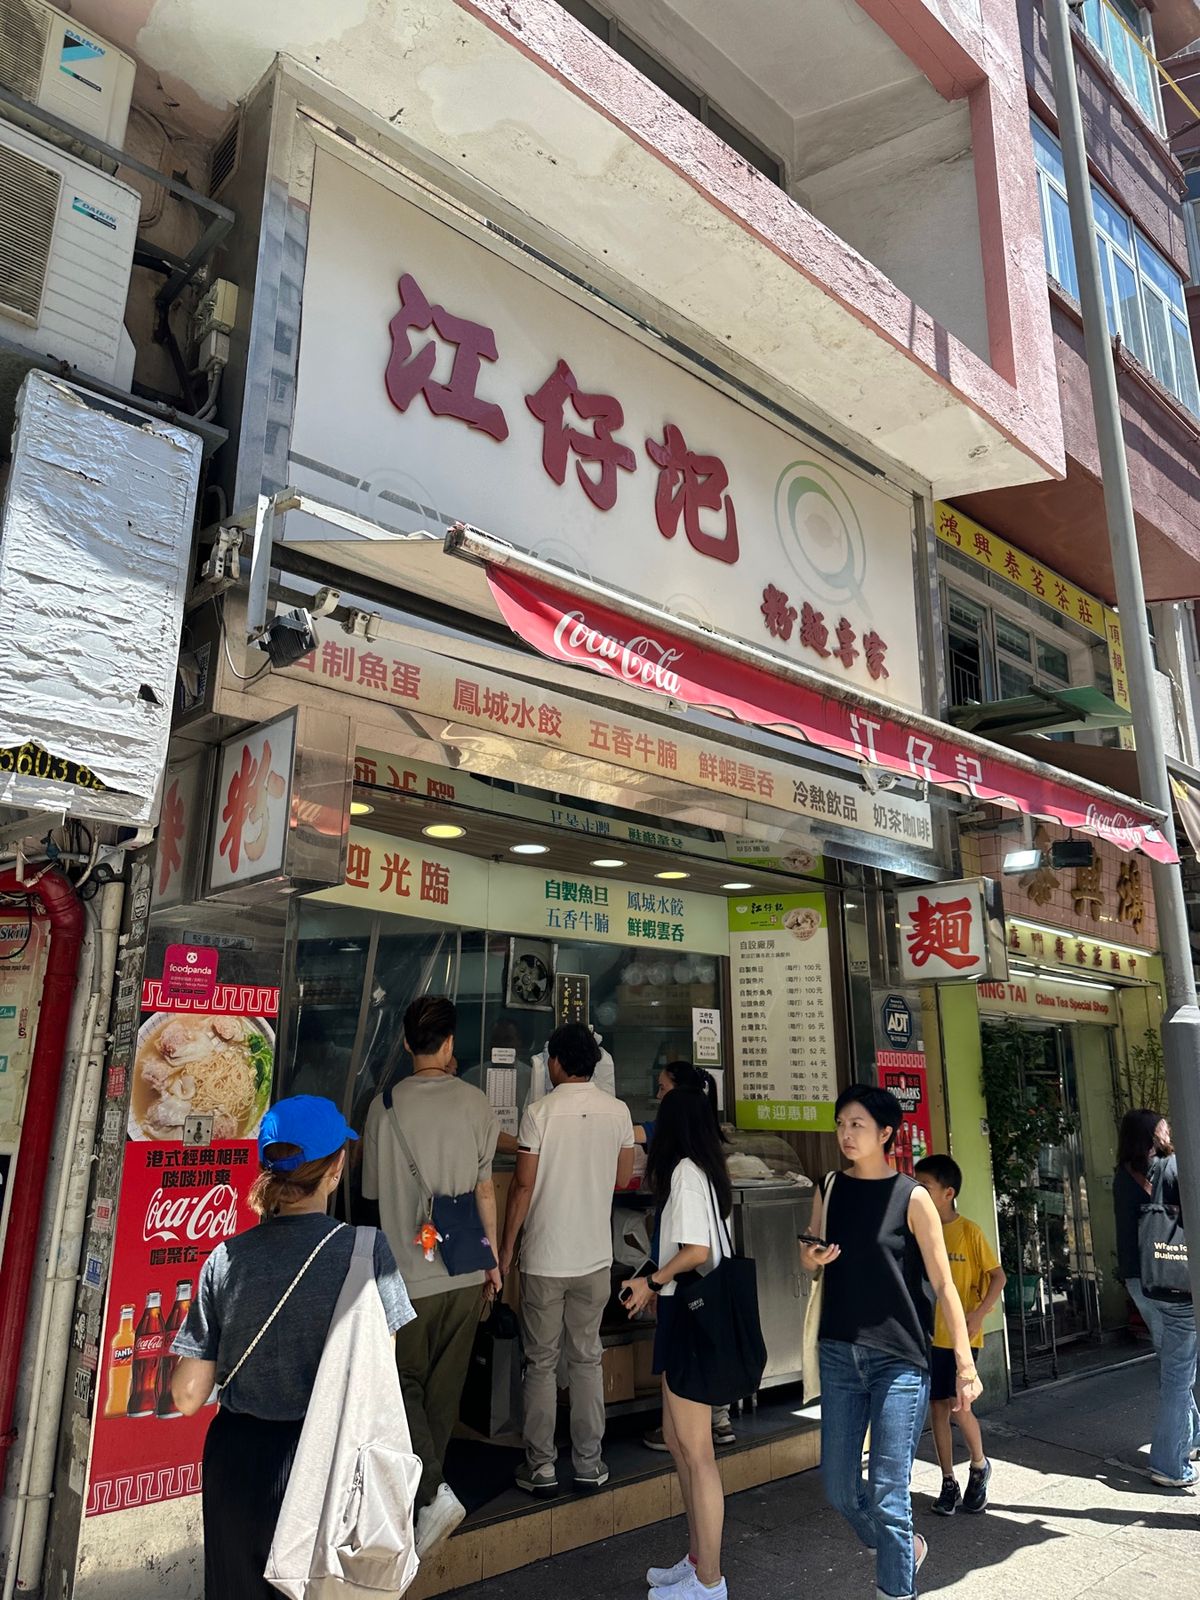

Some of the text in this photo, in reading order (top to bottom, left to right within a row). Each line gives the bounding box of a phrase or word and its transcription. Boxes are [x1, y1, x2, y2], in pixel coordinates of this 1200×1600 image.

[65, 29, 105, 55] DAIKIN
[82, 203, 117, 222] DAIKIN
[939, 511, 1093, 625] 鴻興泰茗茶莊
[453, 677, 562, 738] 鳳城水餃
[588, 719, 677, 771] 五香牛腩
[698, 752, 774, 798] 鮮蝦雲吞
[793, 779, 858, 822] 冷熱飲品
[873, 803, 930, 842] 奶茶咖啡
[220, 740, 286, 873] 粉
[545, 880, 685, 917] 自製魚旦 鳳城水餃
[751, 902, 784, 914] 江仔記
[545, 907, 685, 942] 五香牛腩 鮮蝦雲吞
[907, 896, 980, 969] 麵
[169, 964, 212, 975] foodpanda
[1008, 984, 1027, 1003] TAI
[1035, 993, 1055, 1007] China
[1056, 996, 1069, 1009] Tea
[1070, 998, 1092, 1012] Special
[1093, 1000, 1109, 1014] Shop
[888, 1013, 909, 1032] ADT
[146, 1149, 249, 1168] 港式經典相聚
[162, 1169, 231, 1188] 啖啖冰爽
[143, 1184, 238, 1241] Coca-Cola
